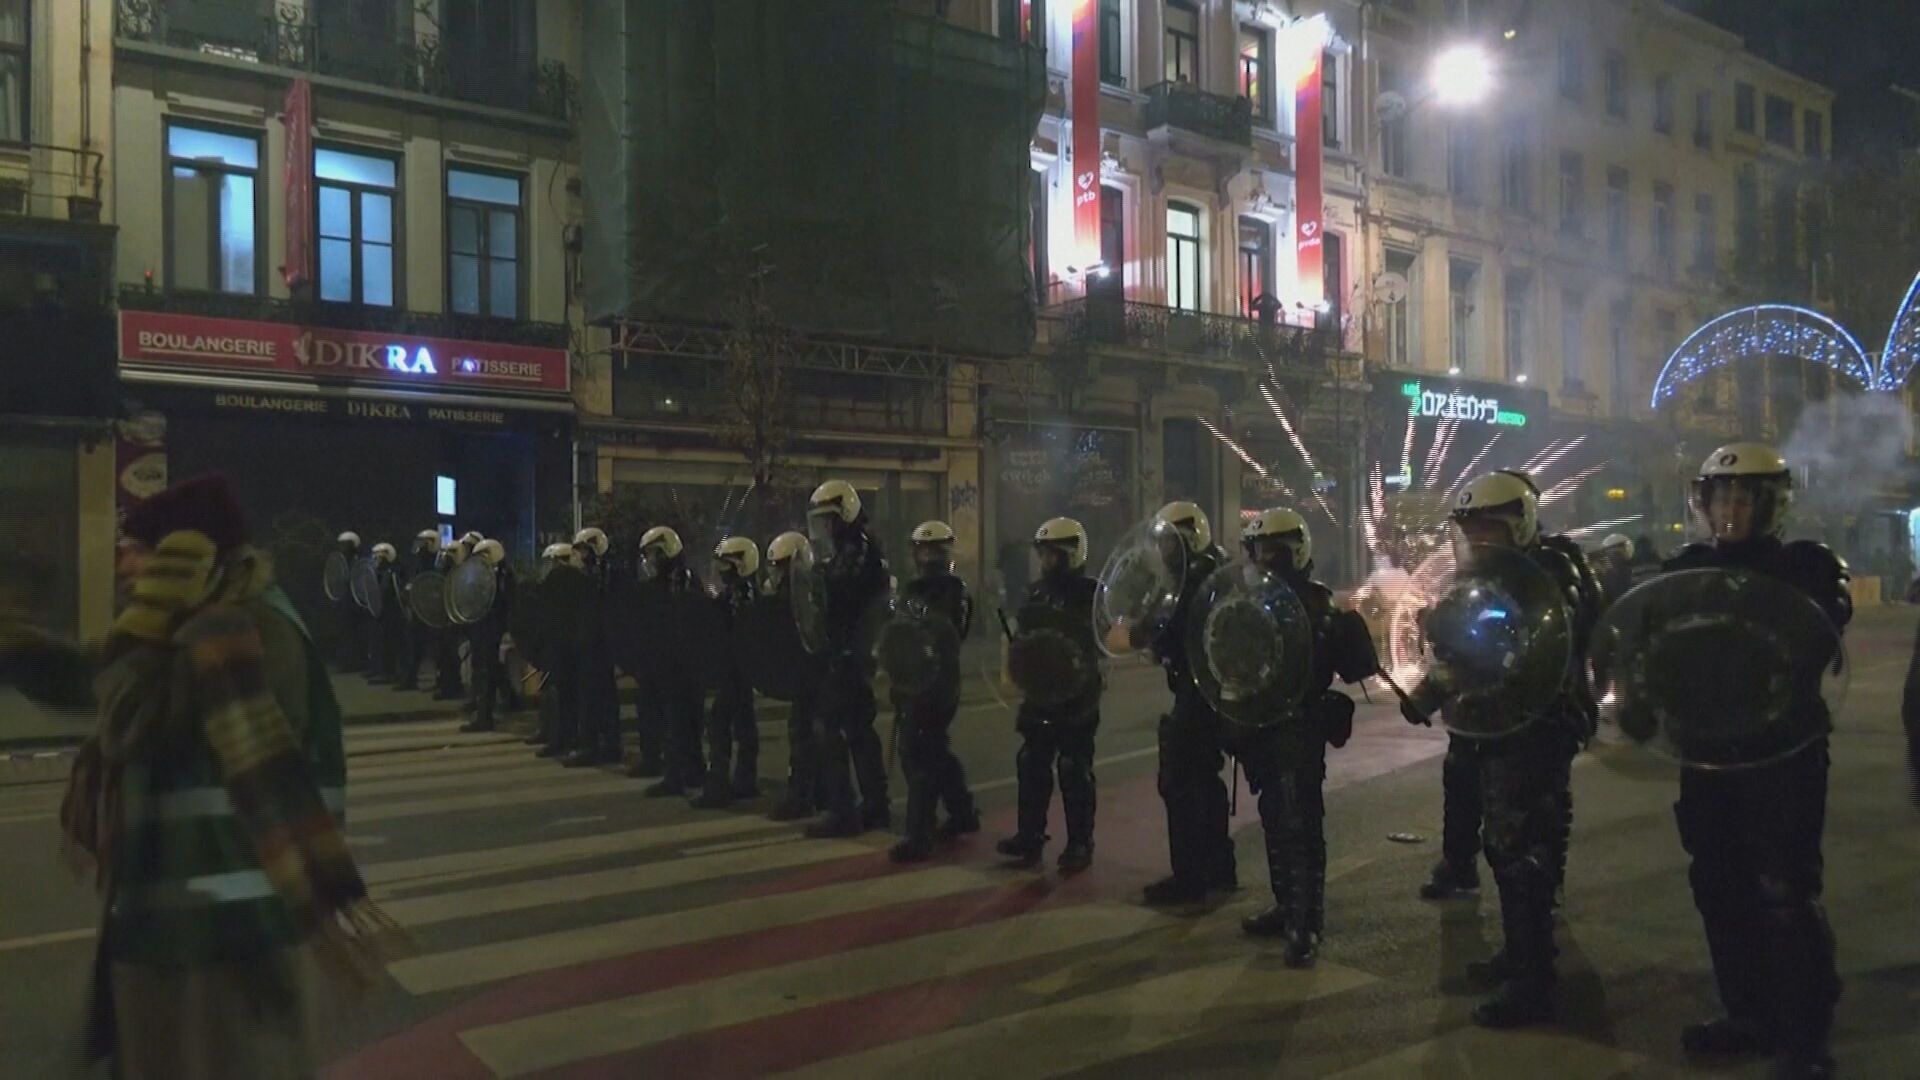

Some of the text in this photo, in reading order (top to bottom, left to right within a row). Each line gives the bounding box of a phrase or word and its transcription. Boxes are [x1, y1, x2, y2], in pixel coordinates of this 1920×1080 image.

[1077, 190, 1096, 208] ptb
[138, 331, 543, 378] BOULANGERIE DIKRA PATISSERIE
[215, 393, 504, 424] BOULANGERIE DIKRA PATISSERIE
